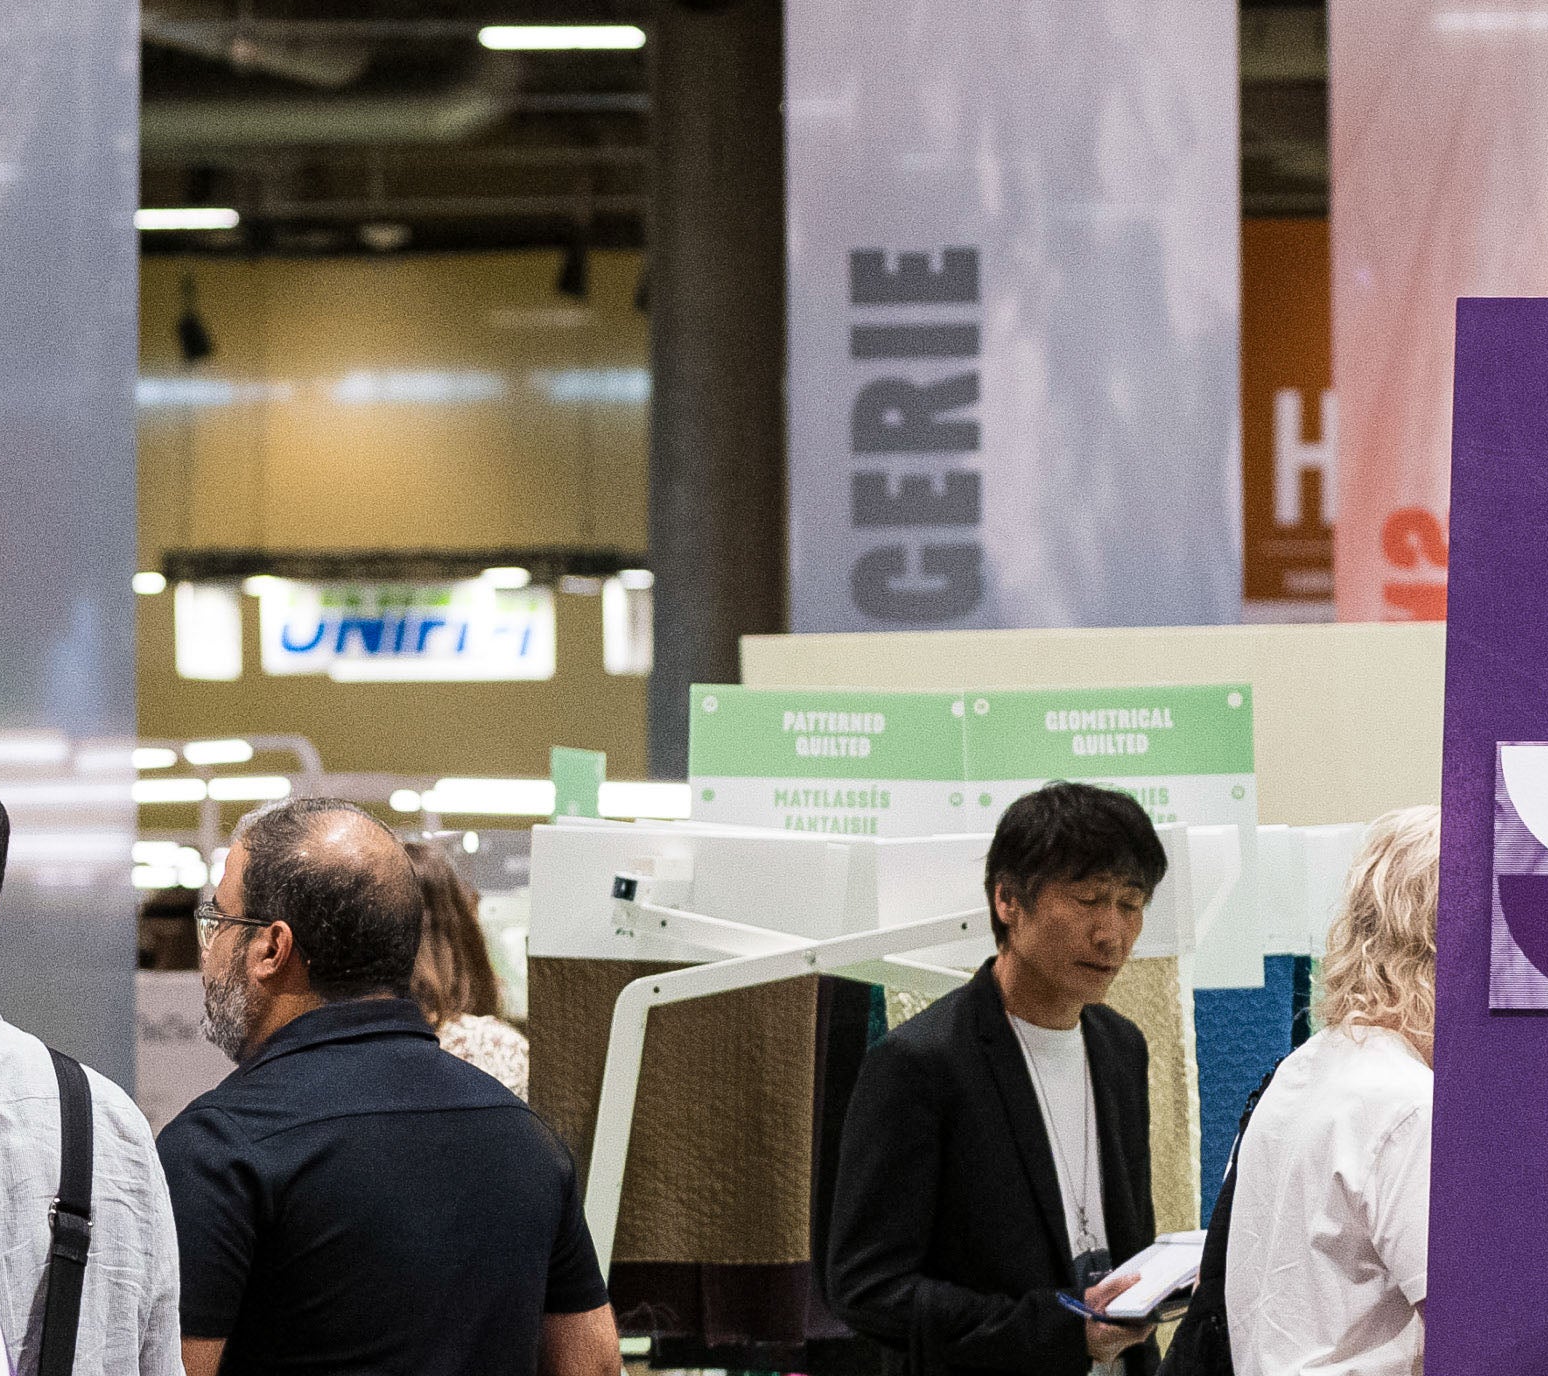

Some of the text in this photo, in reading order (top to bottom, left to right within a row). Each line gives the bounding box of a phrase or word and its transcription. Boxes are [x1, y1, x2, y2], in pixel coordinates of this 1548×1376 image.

[781, 711, 885, 735] PATTERNED
[1044, 708, 1174, 731] GEOMETRICAL
[795, 735, 871, 758] QUILTED
[1071, 732, 1149, 756] QUILTED
